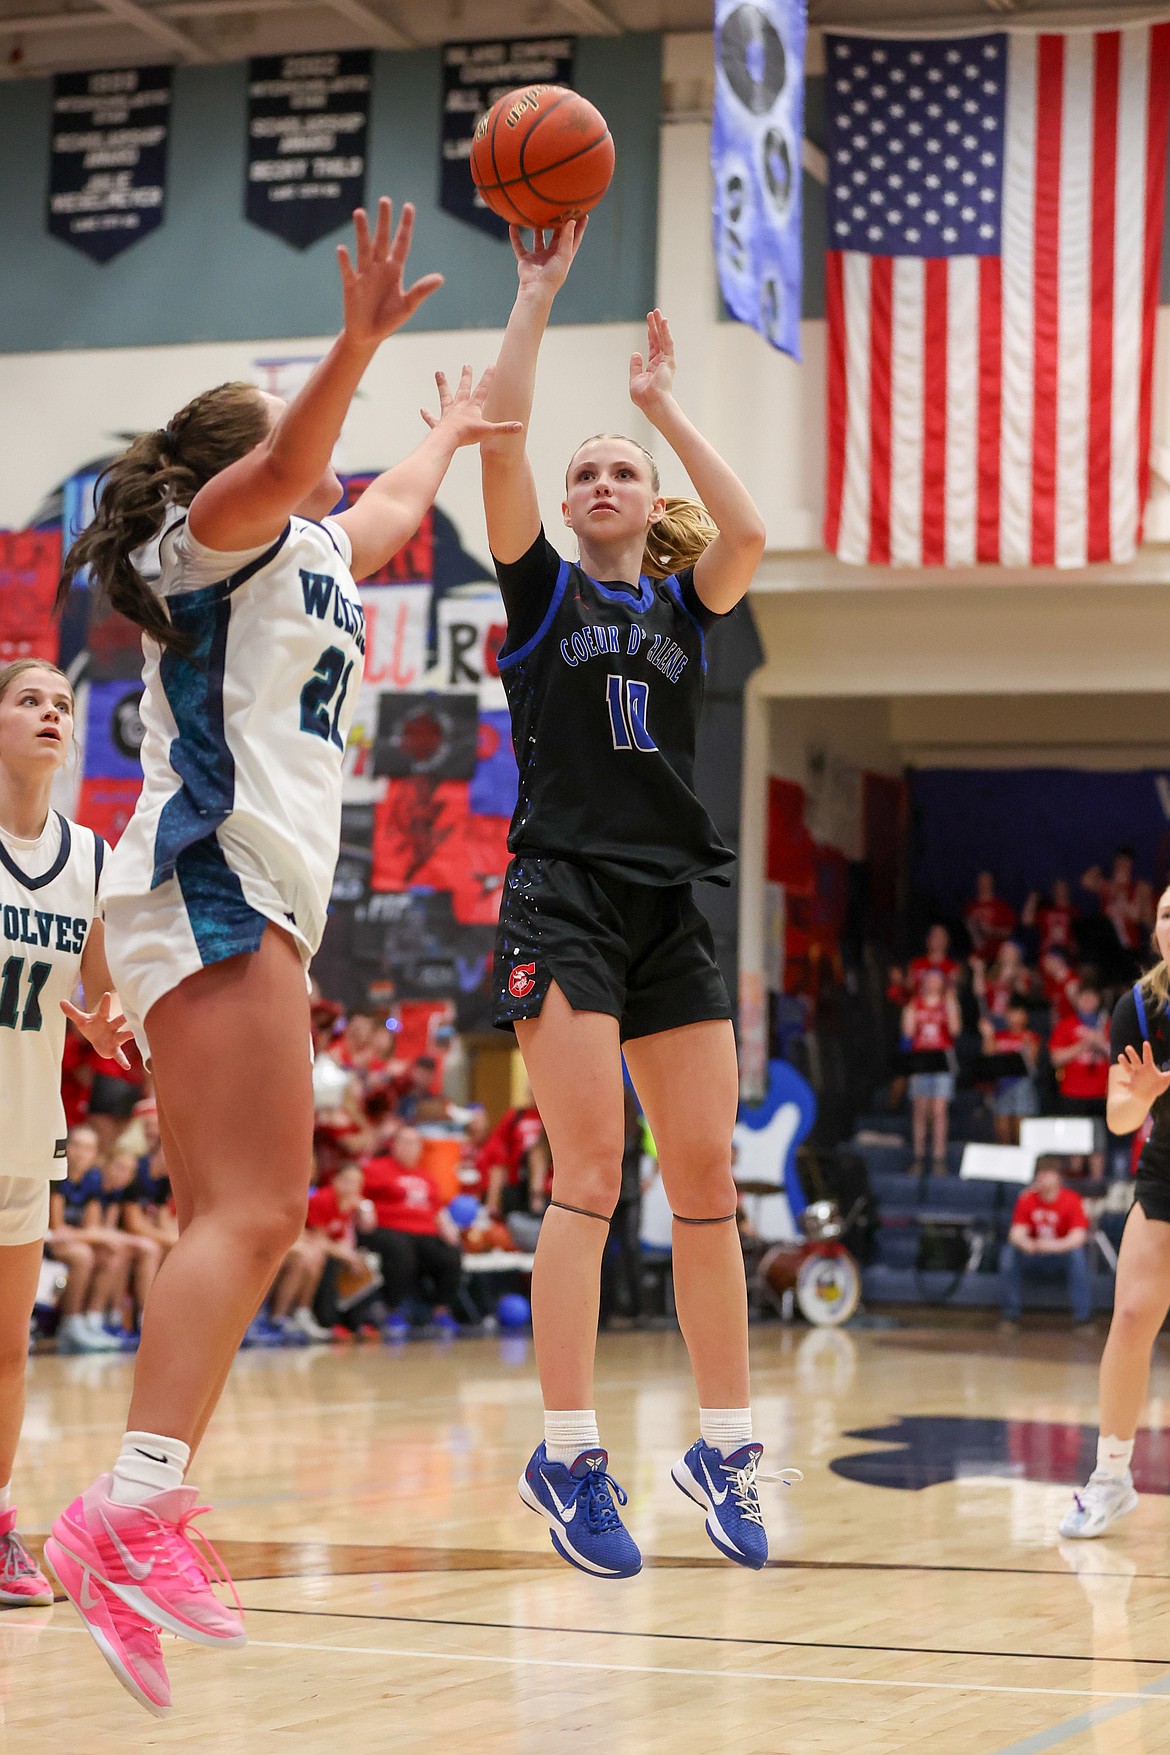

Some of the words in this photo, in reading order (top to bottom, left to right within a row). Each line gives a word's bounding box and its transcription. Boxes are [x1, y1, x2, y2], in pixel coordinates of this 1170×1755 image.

[560, 625, 620, 667] COEUR
[646, 633, 689, 684] ALENE
[299, 644, 355, 753] 21
[605, 673, 660, 753] 10
[0, 902, 88, 955] OLVES
[0, 955, 53, 1032] 11
